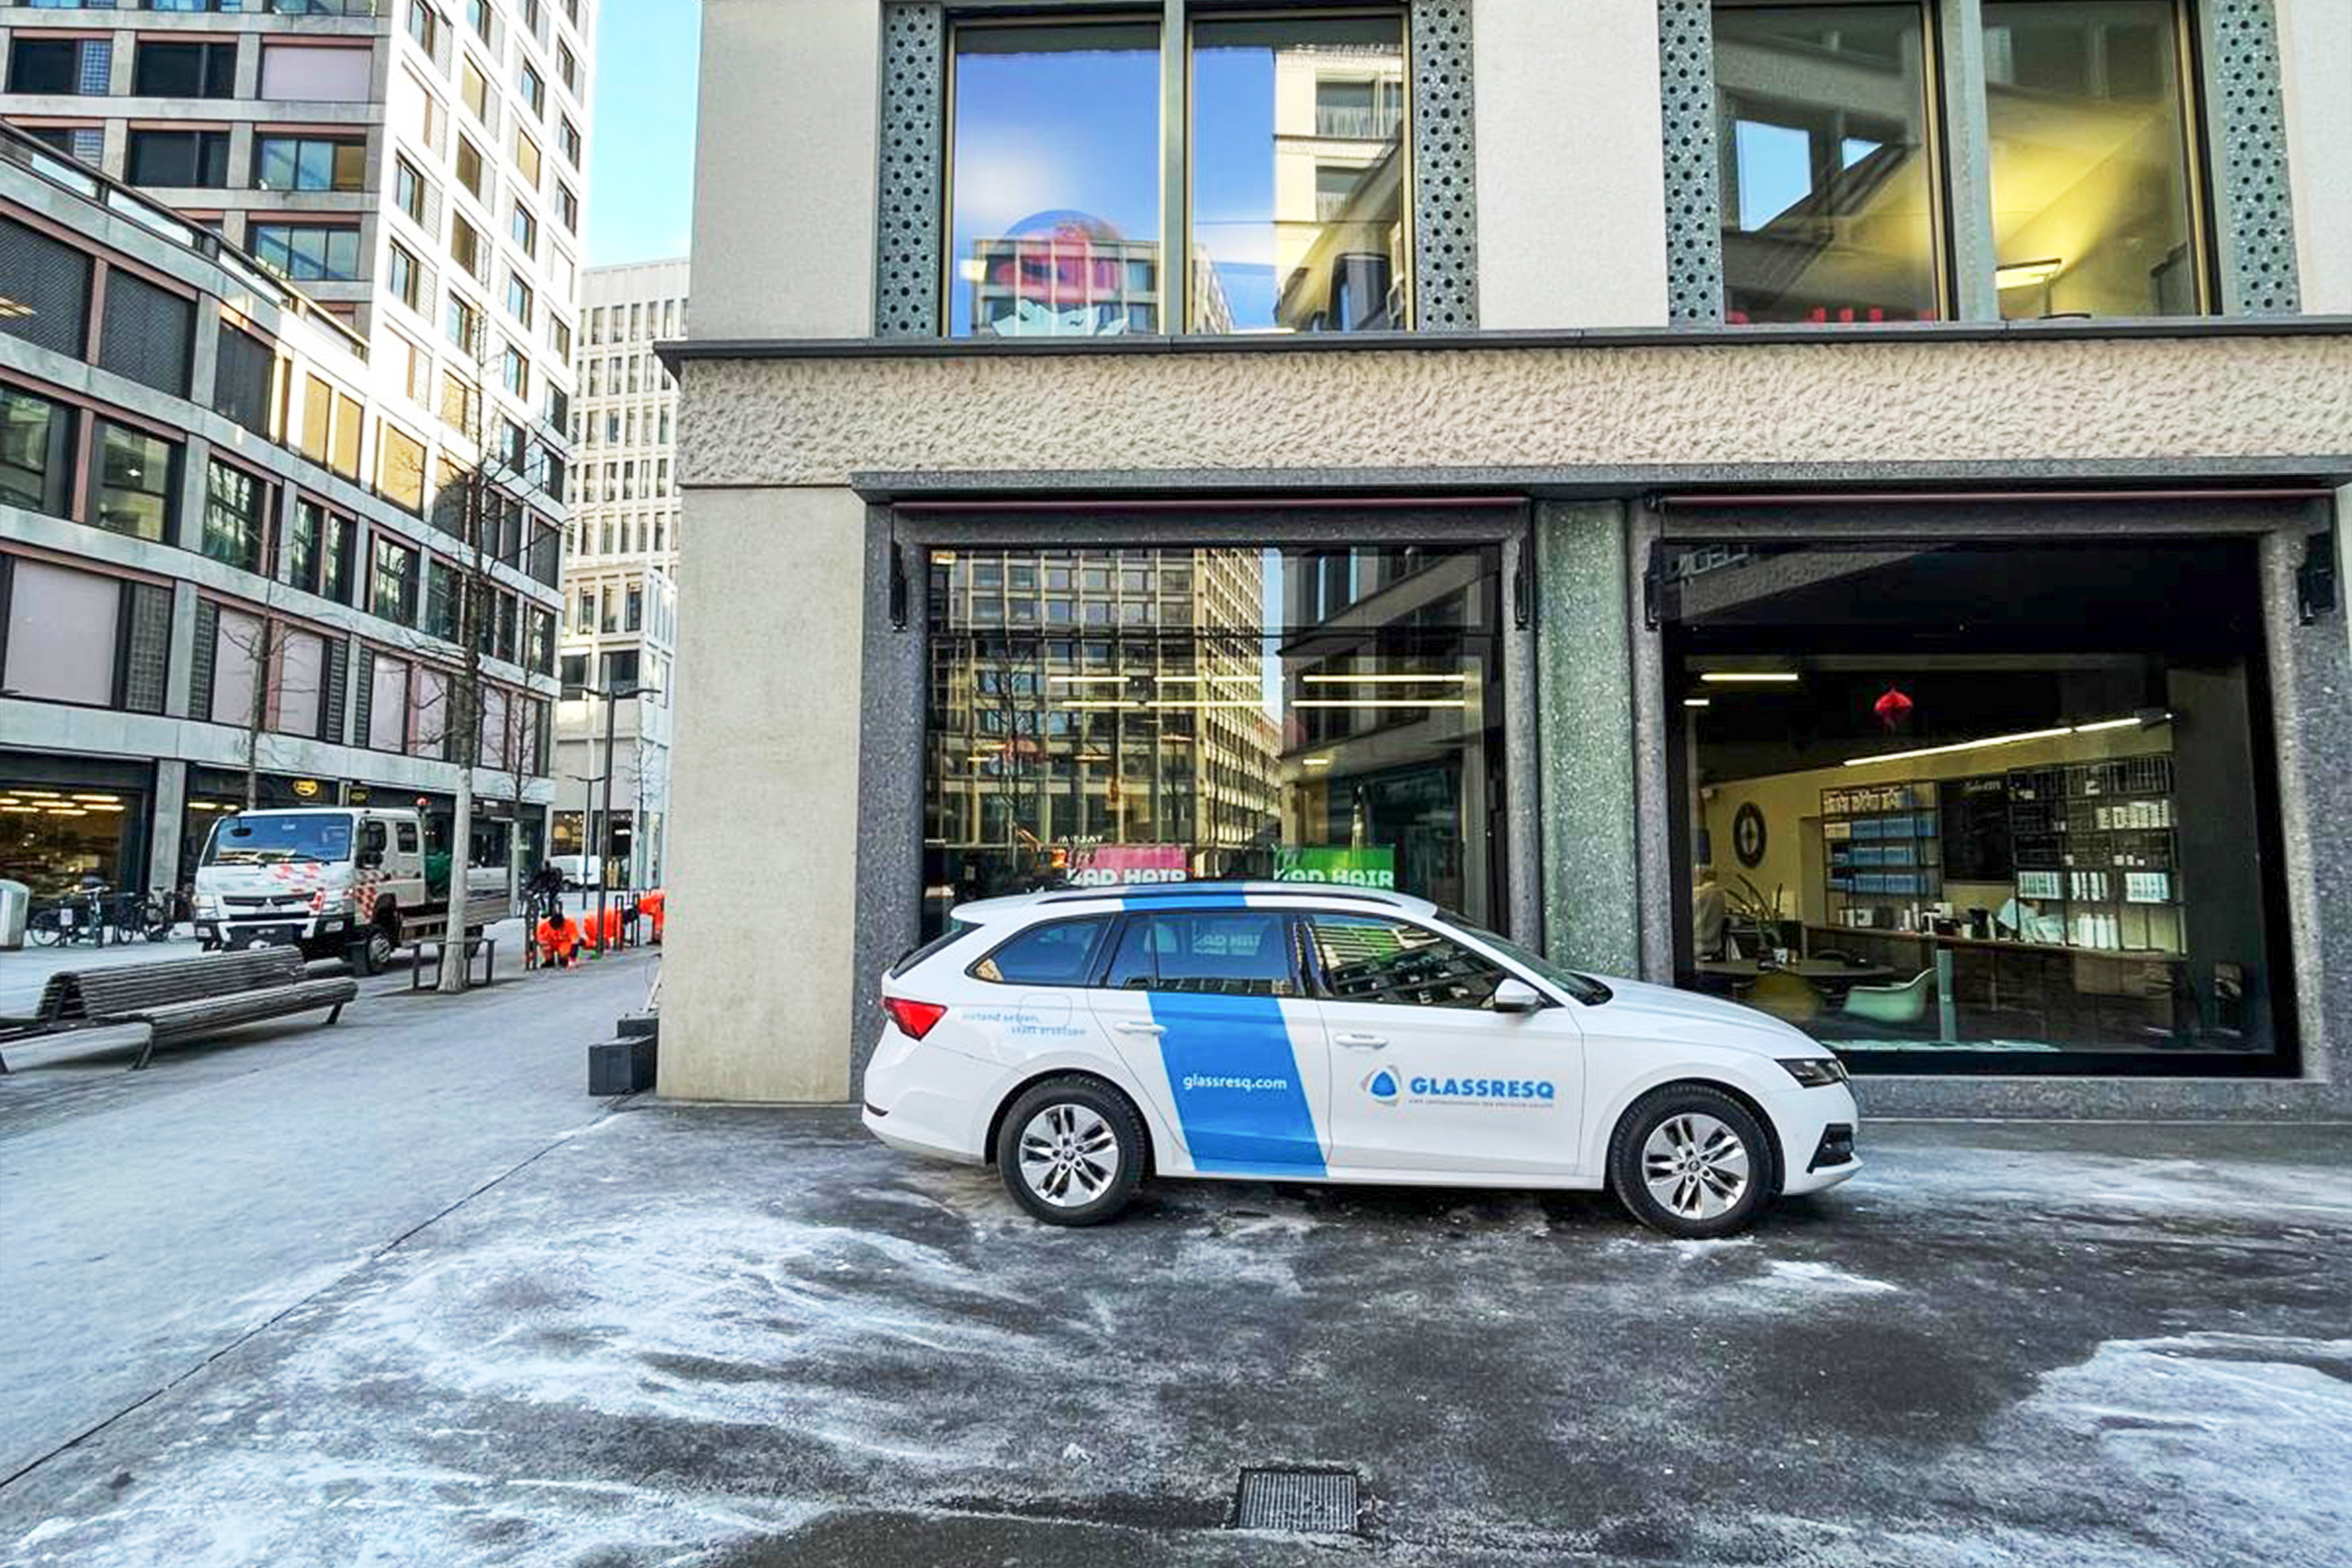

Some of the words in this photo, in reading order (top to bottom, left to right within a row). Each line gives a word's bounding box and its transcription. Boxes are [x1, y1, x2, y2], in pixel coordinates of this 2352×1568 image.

[1332, 868, 1394, 887] HAIR
[1182, 1073, 1287, 1092] glassresq.com
[1410, 1076, 1555, 1100] GLASSRESQ
